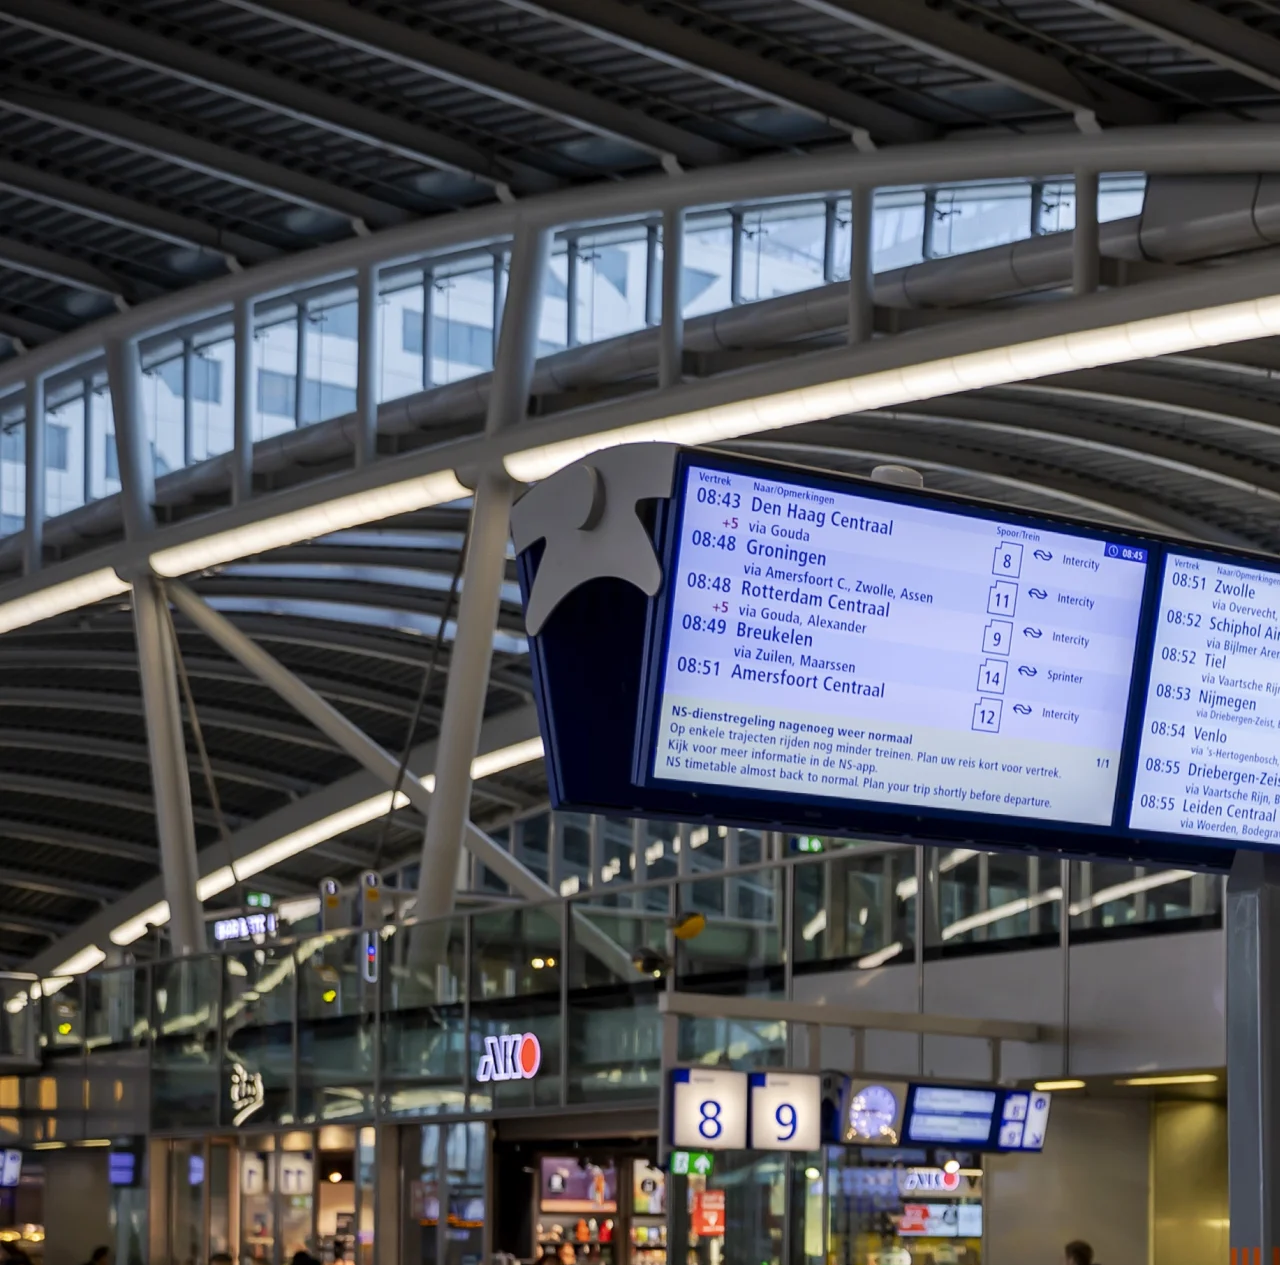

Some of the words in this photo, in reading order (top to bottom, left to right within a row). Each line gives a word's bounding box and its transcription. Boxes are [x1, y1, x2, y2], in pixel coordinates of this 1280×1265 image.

[698, 471, 732, 487] Vertrek
[696, 486, 741, 509] 08:43
[753, 481, 835, 506] Naar/Opmerkingen
[722, 516, 739, 530] +5
[751, 496, 782, 517] Den
[786, 502, 826, 528] Haag
[830, 510, 894, 536] Centraal
[691, 529, 737, 552] 08:48
[748, 519, 767, 535] via
[770, 523, 810, 542] Gouda
[996, 525, 1041, 542] Spoor/Trein
[746, 538, 827, 568] Groningen
[1002, 553, 1012, 569] 8
[1062, 554, 1100, 573] Intercity
[1122, 548, 1144, 561] 08:45
[687, 571, 732, 593] 08:48
[743, 562, 762, 577] via
[765, 565, 834, 588] Amersfoort
[837, 577, 851, 593] C.,
[855, 580, 896, 600] Zwolle,
[899, 587, 934, 604] Assen
[1171, 571, 1206, 591] 08:51
[1213, 578, 1256, 600] Zwolle
[712, 600, 729, 614] +5
[741, 580, 823, 608] Rotterdam
[827, 593, 891, 618] Centraal
[995, 592, 1009, 609] 11
[1057, 592, 1095, 611] Intercity
[682, 613, 727, 635] 08:49
[738, 603, 757, 618] via
[760, 607, 803, 627] Gouda,
[806, 614, 867, 634] Alexander
[1166, 609, 1202, 628] 08:52
[1209, 616, 1262, 638] Schiphol
[736, 621, 813, 648] Breukelen
[992, 631, 1002, 647] 9
[1052, 631, 1090, 649] Intercity
[733, 645, 752, 660] via
[755, 647, 795, 667] Zuilen,
[799, 653, 856, 674] Maarssen
[1161, 646, 1197, 665] 08:52
[1204, 652, 1227, 671] Tiel
[677, 656, 721, 677] 08:51
[1047, 669, 1083, 684] Sprinter
[730, 663, 818, 690] Amersfoort
[823, 675, 886, 698] Centraal
[985, 670, 1000, 686] 14
[1156, 683, 1192, 701] 08:53
[1198, 688, 1257, 713] Nijmegen
[671, 705, 776, 731] NS-dienstregeling
[778, 720, 835, 739] nagenoeg
[837, 727, 866, 739] weer
[867, 731, 913, 745] normaal
[980, 709, 995, 725] 12
[1042, 707, 1080, 725] Intercity
[1150, 720, 1186, 738] 08:54
[1193, 725, 1228, 744] Venlo
[667, 738, 689, 754] Kijk
[692, 743, 718, 755] voor
[720, 746, 749, 758] meer
[751, 747, 807, 765] informatie
[809, 754, 820, 767] in
[822, 756, 836, 769] de
[838, 758, 878, 776] NS-app.
[669, 721, 686, 737] Op
[688, 725, 726, 739] enkele
[728, 729, 777, 745] trajecten
[779, 735, 811, 750] rijden
[812, 741, 834, 755] nog
[835, 742, 873, 757] minder
[875, 747, 914, 761] treinen.
[916, 751, 938, 764] Plan
[940, 756, 957, 766] uw
[958, 757, 976, 769] reis
[978, 758, 999, 771] kort
[1001, 763, 1023, 774] voor
[1025, 766, 1062, 778] vertrek.
[1096, 757, 1110, 769] 1/1
[1145, 757, 1181, 775] 08:55
[665, 755, 681, 768] NS
[684, 757, 738, 774] timetable
[739, 763, 777, 779] almost
[779, 767, 804, 781] back
[807, 771, 819, 783] to
[821, 774, 859, 787] normal.
[862, 776, 885, 790] Plan
[887, 782, 910, 793] your
[913, 783, 931, 797] trip
[933, 785, 968, 801] shortly
[969, 788, 1002, 803] before
[1003, 792, 1053, 808] departure.
[1140, 793, 1175, 811] 08:55
[1185, 782, 1200, 796] via
[1202, 784, 1249, 801] Vaartsche
[1250, 790, 1271, 806] Rijn,
[1182, 798, 1223, 817] Leiden
[1226, 803, 1277, 823] Centraal
[476, 1032, 541, 1082] AKO
[699, 1100, 722, 1139] 8
[776, 1104, 797, 1141] 9
